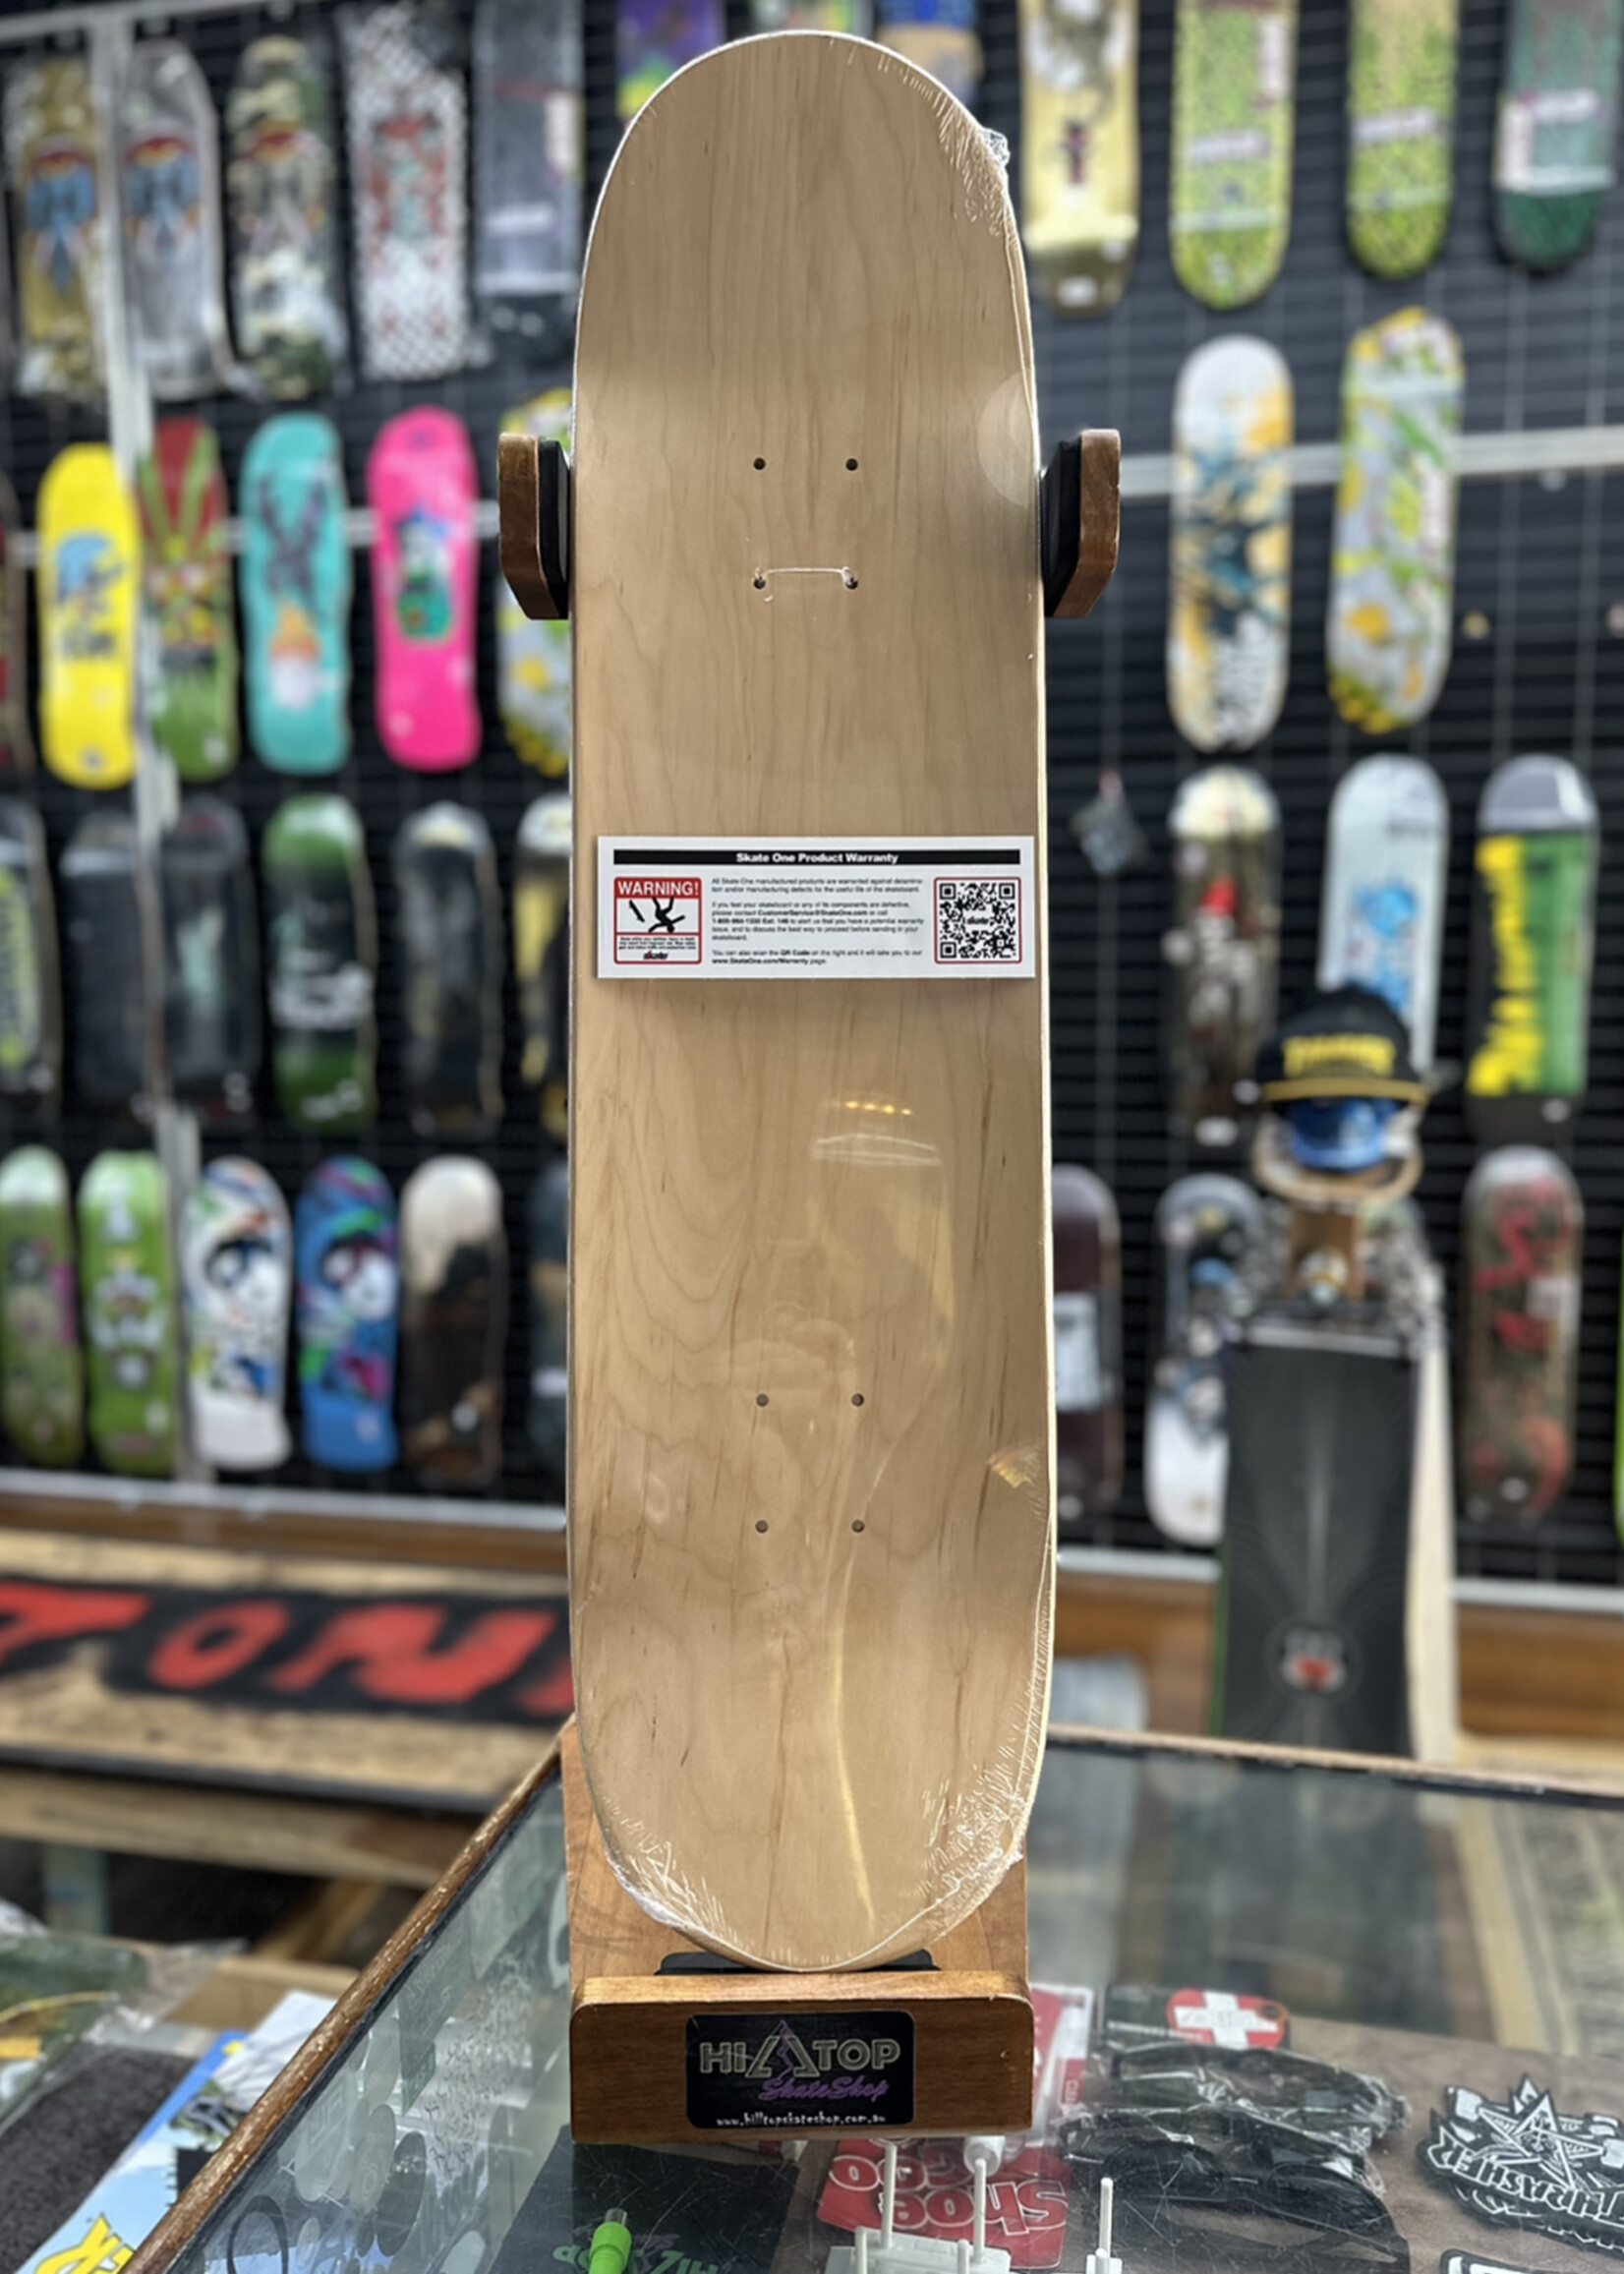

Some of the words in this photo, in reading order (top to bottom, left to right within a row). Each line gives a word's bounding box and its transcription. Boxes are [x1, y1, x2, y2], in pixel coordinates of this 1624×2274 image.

[736, 853, 770, 862] Skate
[772, 853, 795, 862] One
[798, 853, 842, 862] Product
[845, 853, 899, 864] Warranty
[617, 881, 699, 896] WARNING!
[716, 2111, 887, 2127] www.hilltopskateshop.com.au
